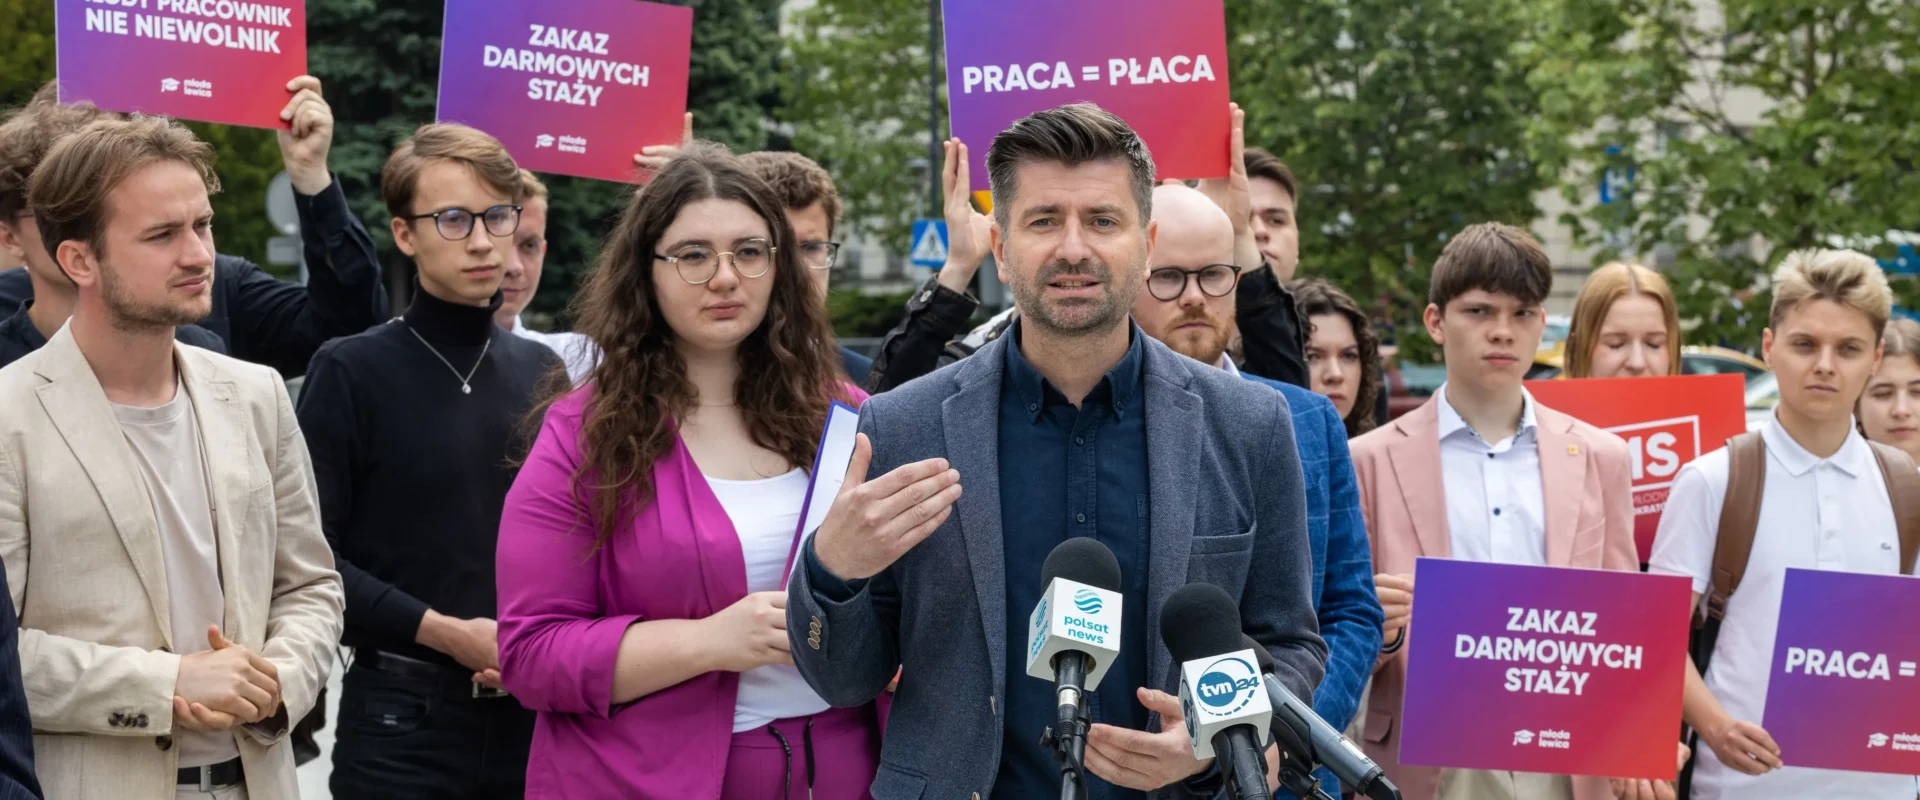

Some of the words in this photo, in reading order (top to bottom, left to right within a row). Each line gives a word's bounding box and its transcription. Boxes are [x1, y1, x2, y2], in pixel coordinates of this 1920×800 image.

[85, 8, 128, 35] NIE
[135, 14, 281, 54] NIEWOLNIK
[528, 24, 609, 55] ZAKAZ
[483, 45, 649, 87] DARMOWYCH
[963, 62, 1075, 93] PRACA
[1109, 55, 1216, 86] PŁACA
[527, 78, 603, 107] STAŻY
[1064, 615, 1109, 634] polsat
[1068, 629, 1104, 644] news
[1506, 607, 1598, 636] ZAKAZ
[1455, 634, 1643, 669] DARMOWYCH
[1785, 647, 1890, 680] PRACA
[1504, 664, 1590, 695] STAŻY
